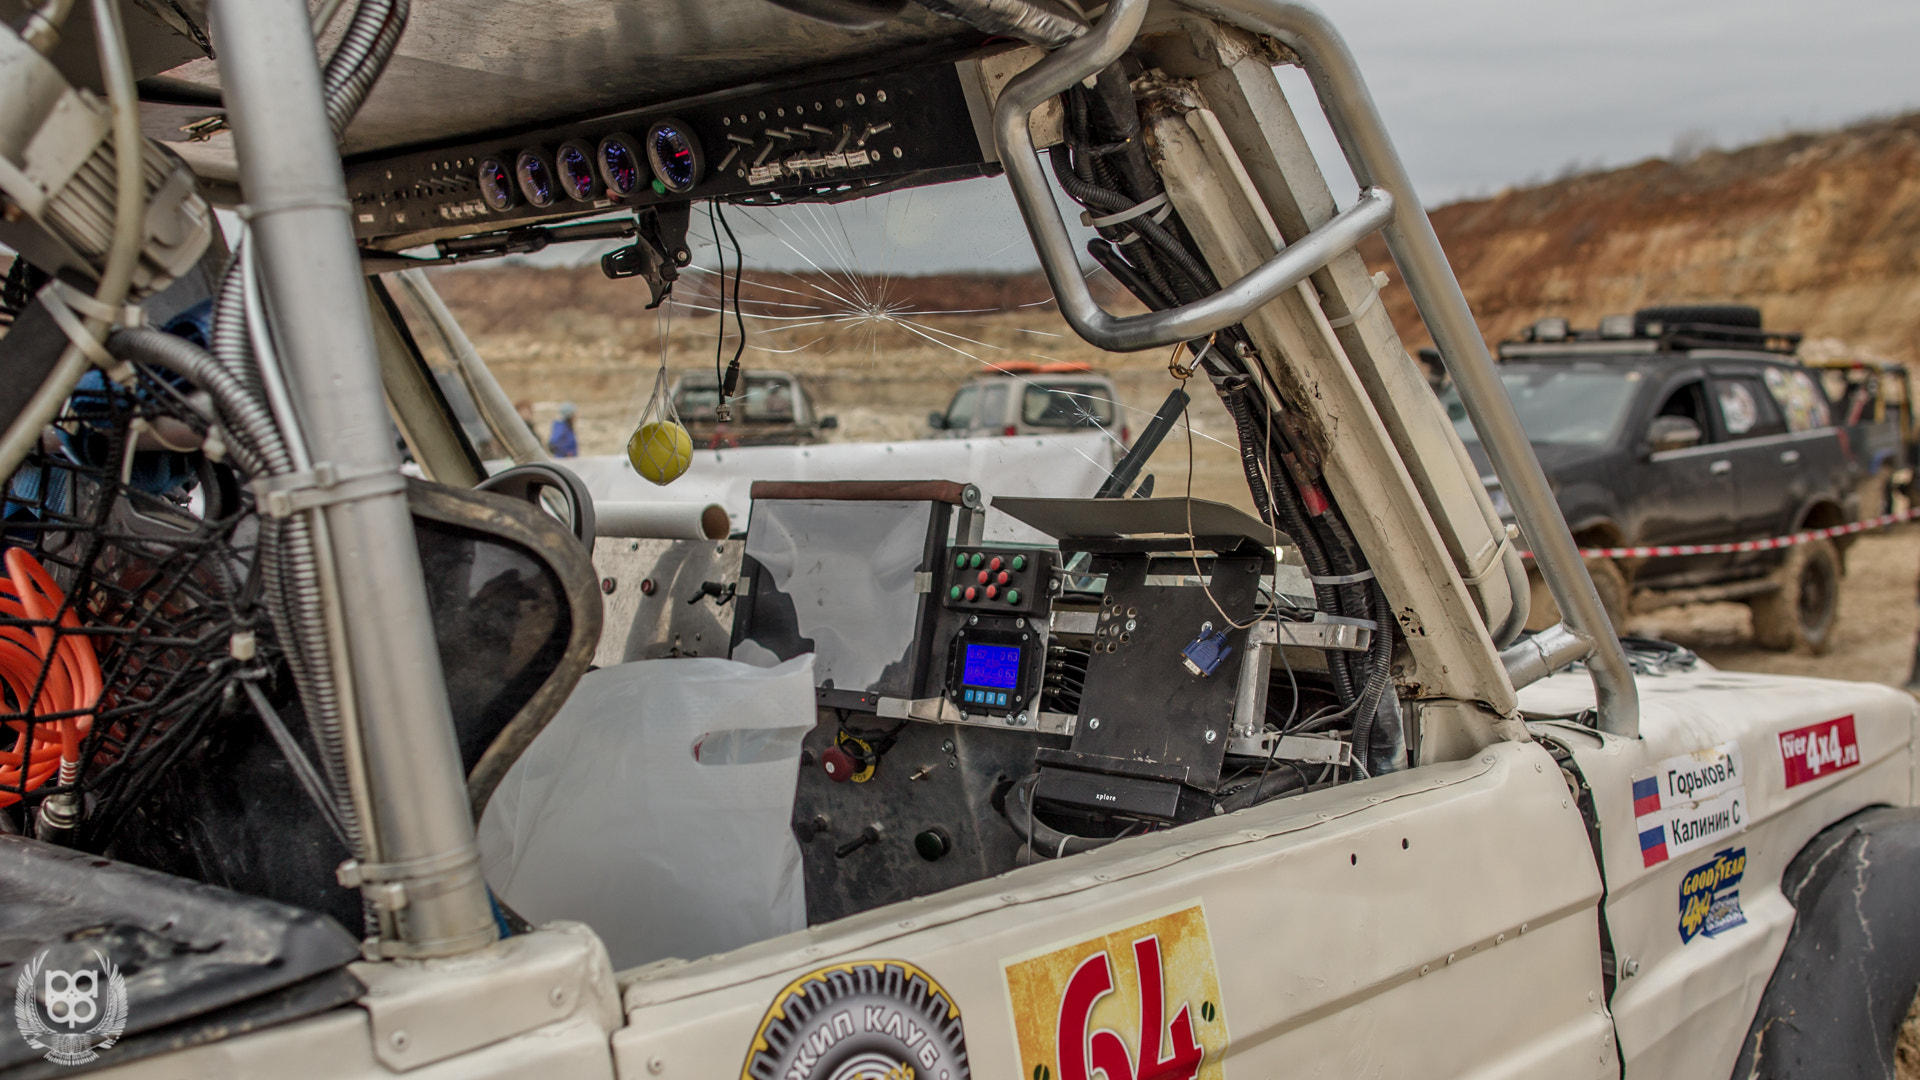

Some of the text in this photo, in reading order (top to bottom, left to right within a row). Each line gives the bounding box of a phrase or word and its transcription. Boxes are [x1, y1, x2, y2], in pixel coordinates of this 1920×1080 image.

[1095, 793, 1117, 802] xplore
[1668, 753, 1736, 799] Горьков А
[1671, 799, 1741, 846] Калинин С
[1055, 933, 1205, 1080] 64
[863, 1005, 941, 1070] КЛУБ
